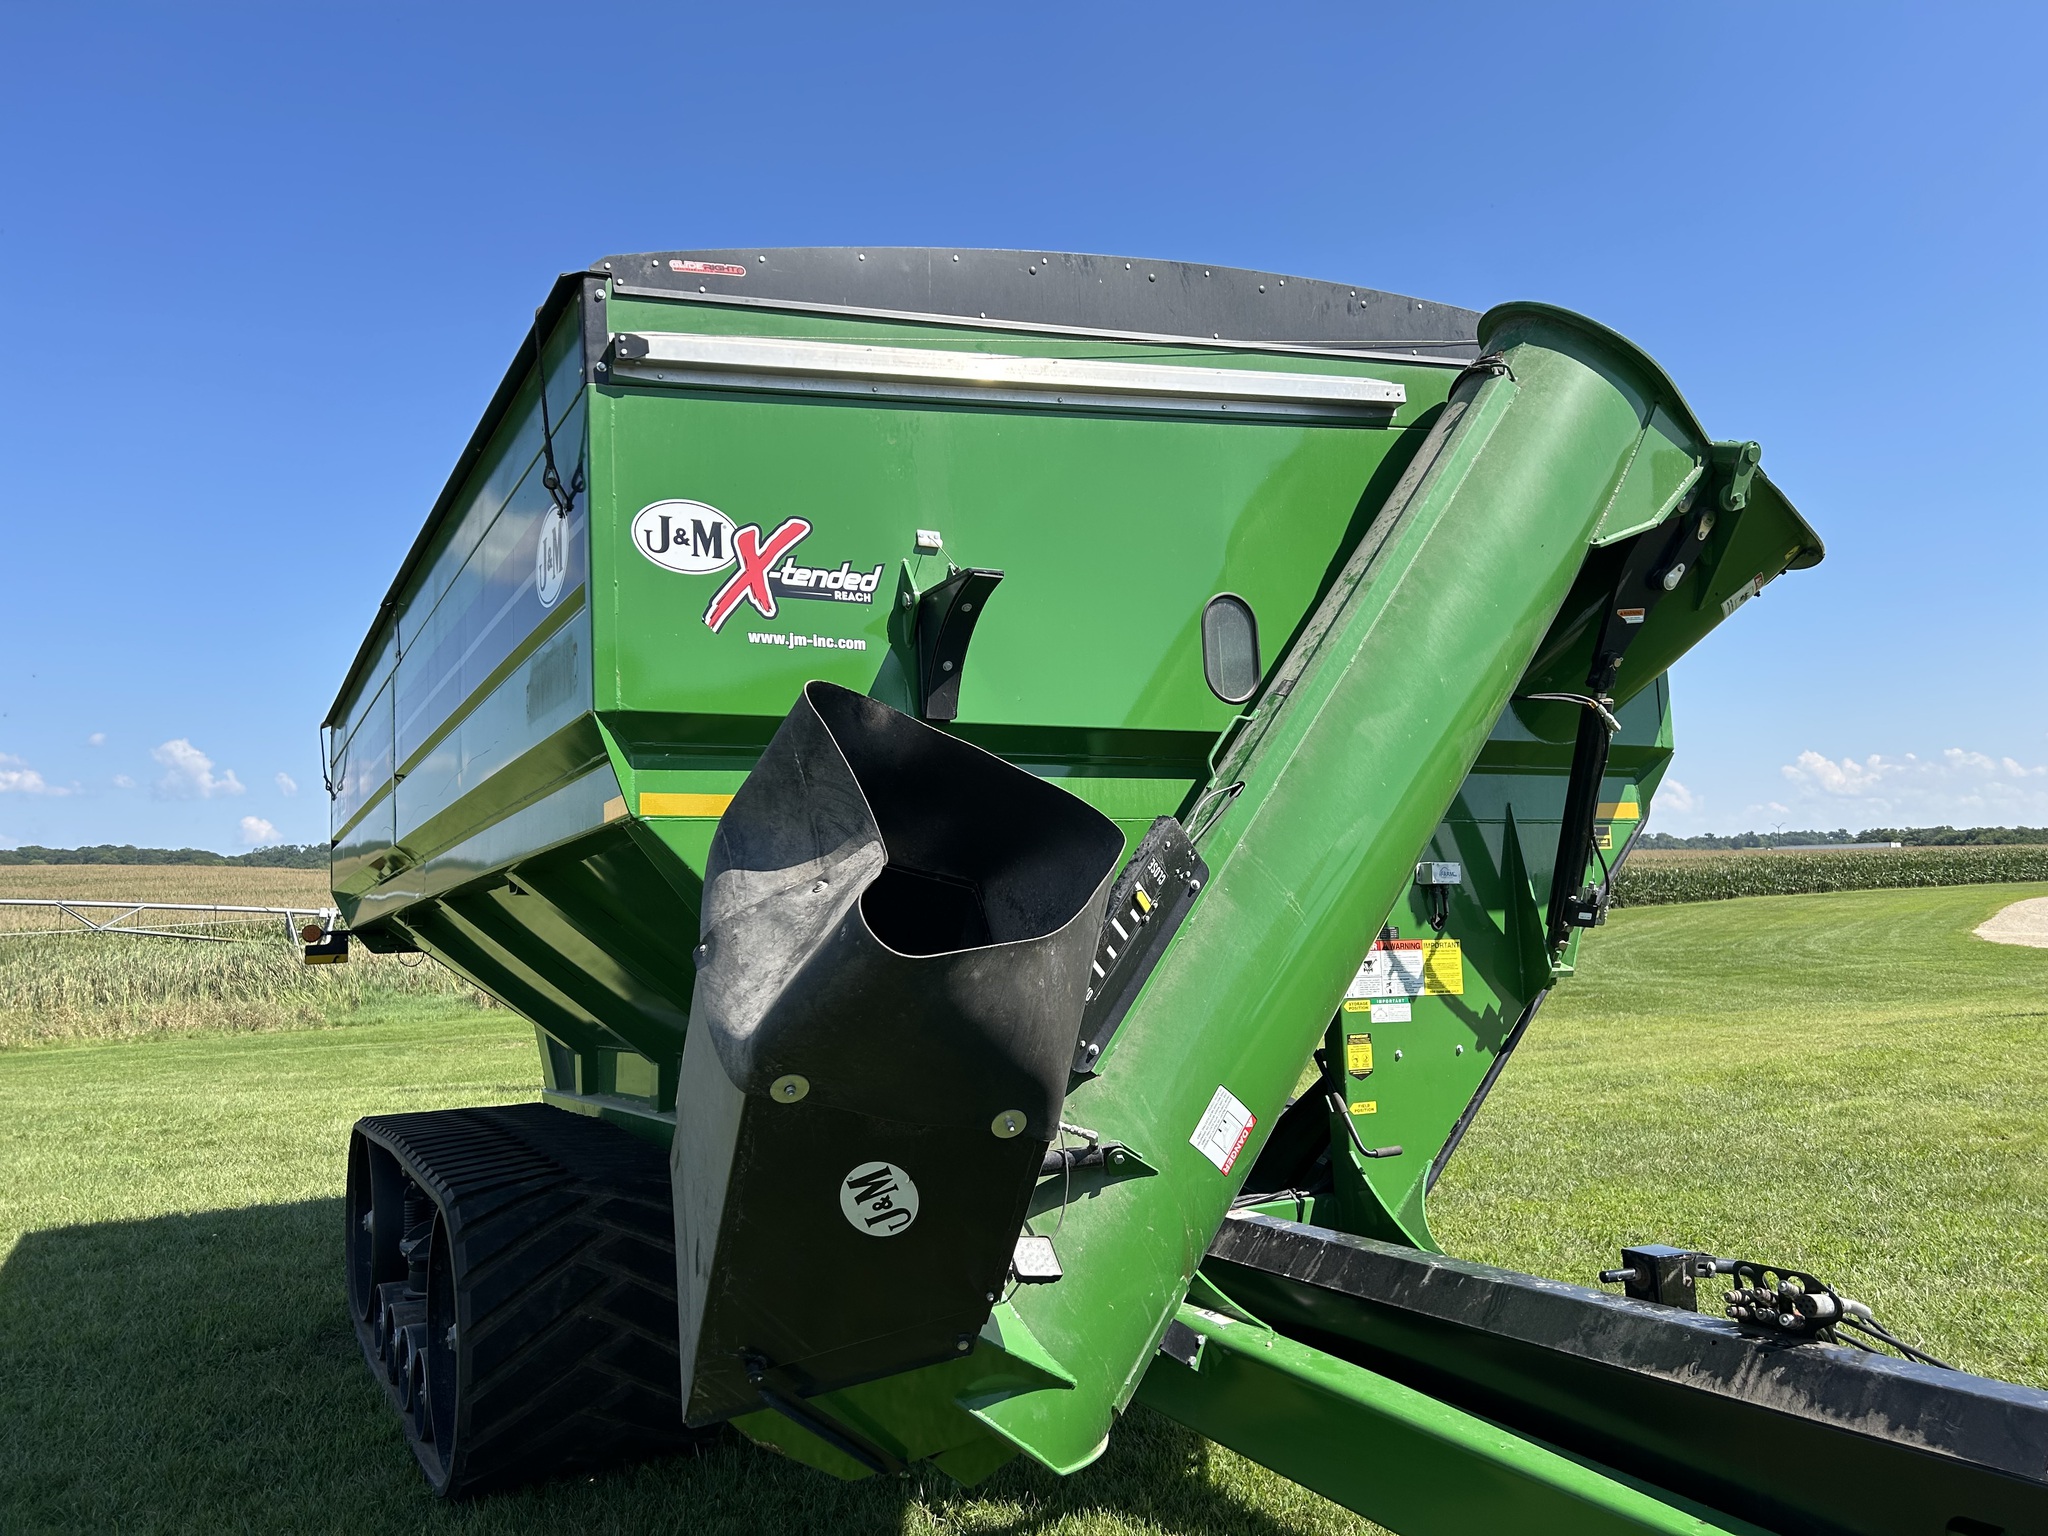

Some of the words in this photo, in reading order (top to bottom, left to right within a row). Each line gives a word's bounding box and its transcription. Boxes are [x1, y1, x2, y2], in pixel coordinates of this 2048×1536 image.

[644, 515, 724, 560] J&M
[538, 518, 564, 592] J&M
[833, 590, 872, 603] REACH
[747, 631, 867, 651] www.jm-inc.com
[1147, 857, 1167, 886] CLOSE
[1390, 942, 1421, 950] WARNING
[1423, 941, 1460, 949] IMPORTANT
[1222, 1129, 1249, 1173] DANGER
[846, 1165, 912, 1232] J&M
